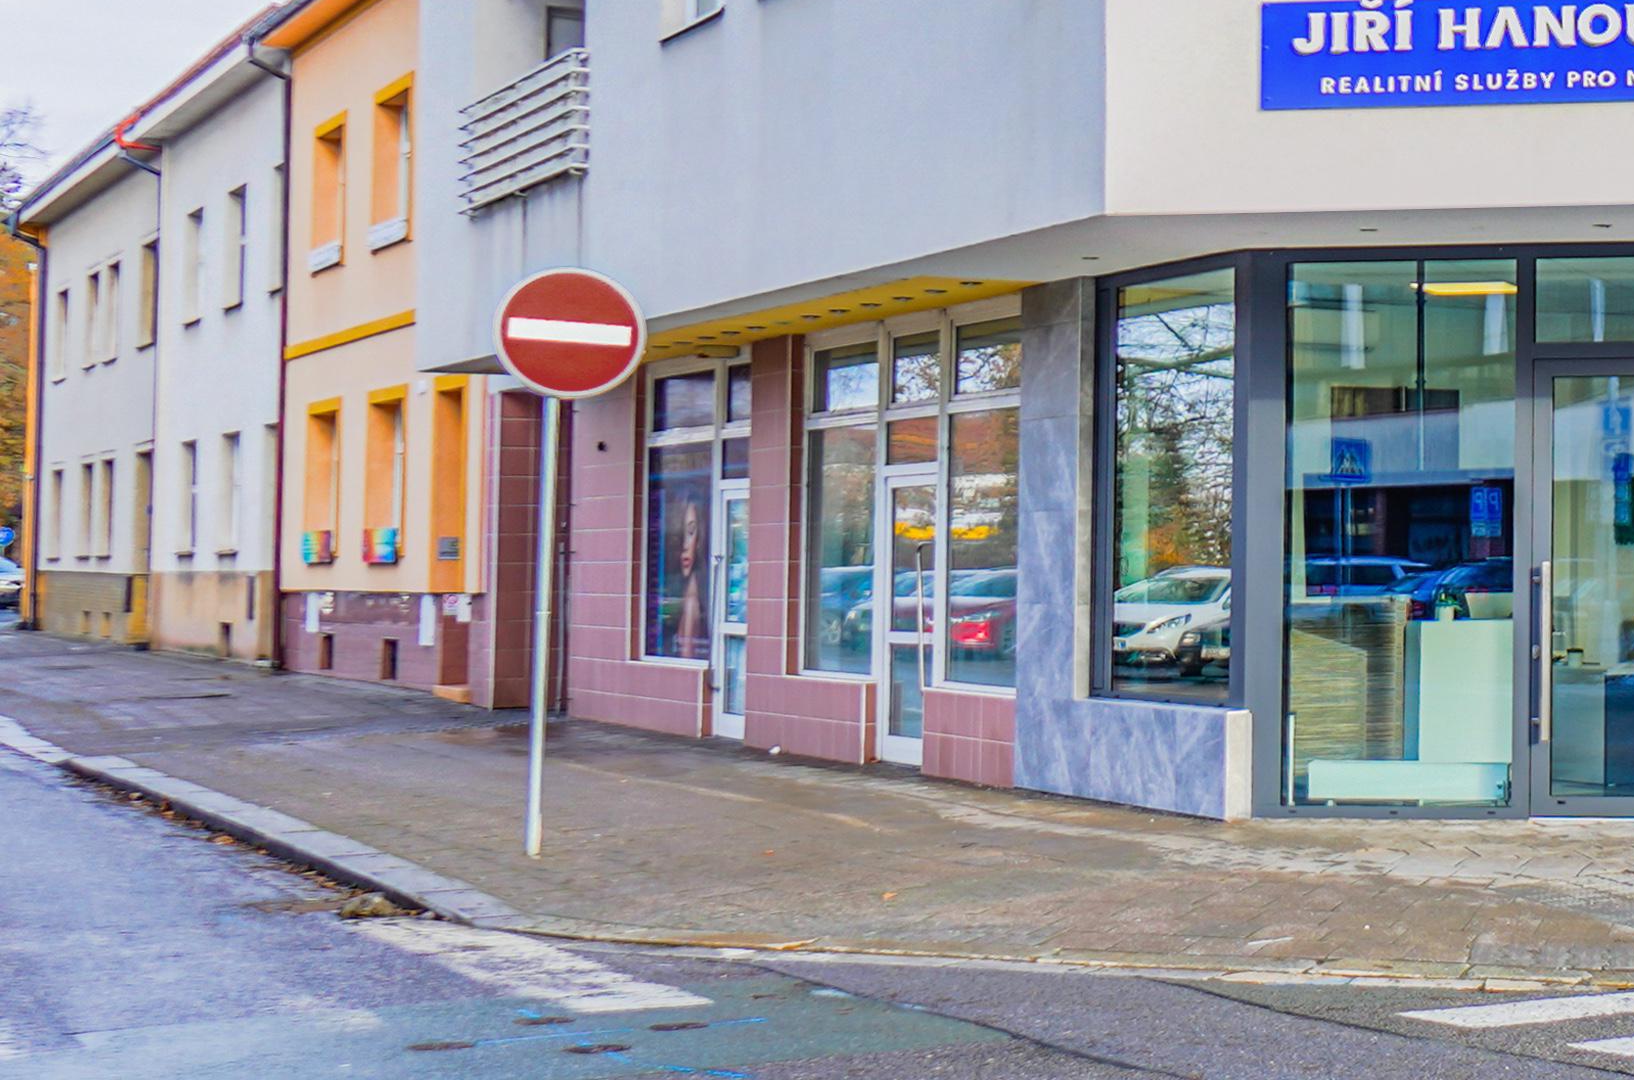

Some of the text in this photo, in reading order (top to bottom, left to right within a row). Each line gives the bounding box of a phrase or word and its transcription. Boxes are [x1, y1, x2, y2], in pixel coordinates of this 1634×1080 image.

[1319, 70, 1443, 95] REALITNÍ
[1454, 68, 1555, 92] SLUŽBY
[1566, 70, 1617, 89] PRO
